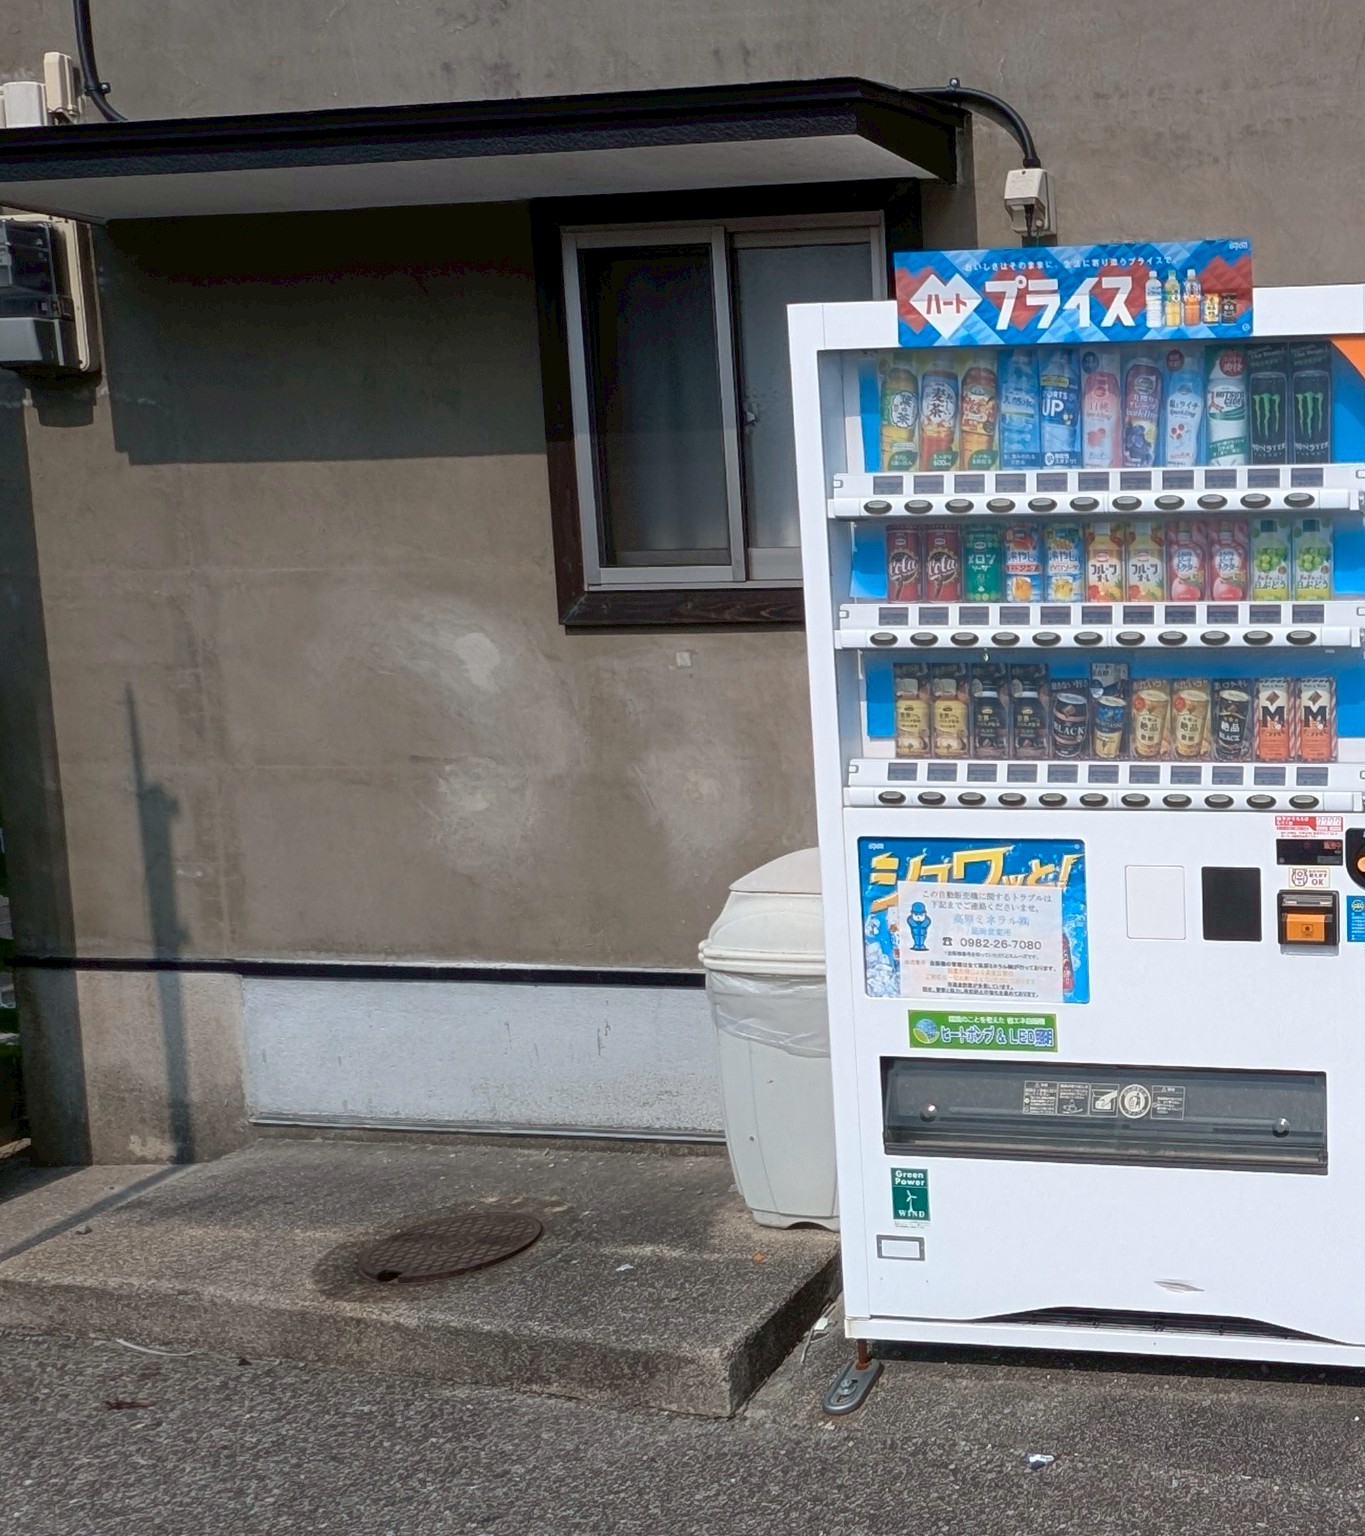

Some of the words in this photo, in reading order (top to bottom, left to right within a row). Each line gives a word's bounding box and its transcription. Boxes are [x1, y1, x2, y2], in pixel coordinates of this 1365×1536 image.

[926, 293, 967, 315] ハート
[985, 275, 1135, 331] プライス
[929, 387, 947, 419] 麦茶
[1042, 400, 1064, 417] UP
[889, 556, 917, 577] Cola
[928, 555, 956, 577] Cola
[1091, 564, 1117, 575] フルーツ
[1131, 564, 1158, 575] フルーツ
[1261, 706, 1285, 728] M
[1303, 706, 1328, 728] M
[1053, 721, 1086, 735] BLACK
[1311, 878, 1324, 886] OK
[922, 890, 1053, 903] この自動販売機に関するトラブルは
[931, 900, 1040, 913] 下記までご連絡くださいませ。
[959, 937, 1042, 950] 0982-26-7080
[940, 1025, 995, 1044] ヒートポンプ
[997, 1027, 1007, 1044] &
[895, 1170, 924, 1179] Green
[895, 1178, 925, 1186] Power
[898, 1209, 925, 1218] WIND
